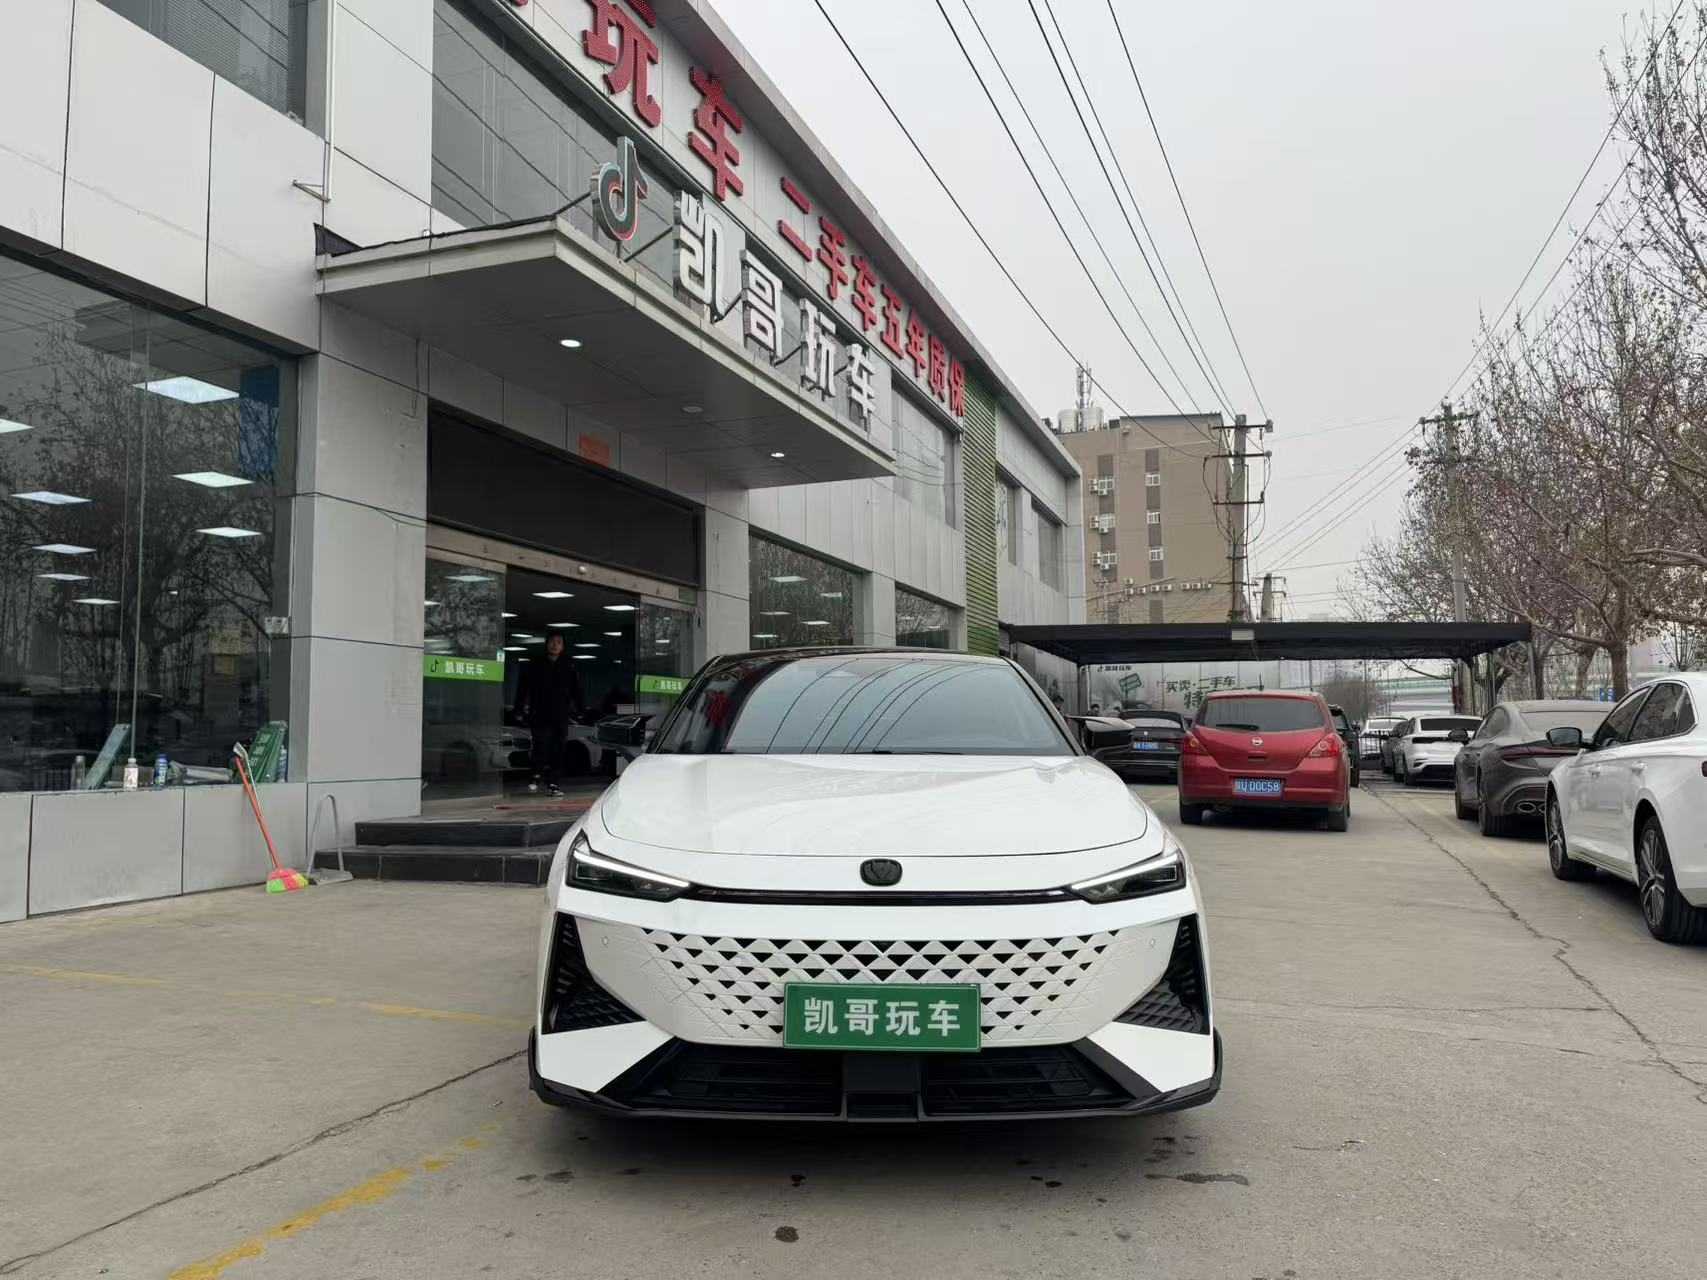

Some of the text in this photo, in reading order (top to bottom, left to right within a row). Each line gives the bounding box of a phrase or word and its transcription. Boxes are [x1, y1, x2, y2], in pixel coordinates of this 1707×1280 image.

[675, 190, 877, 427] 凯哥玩车
[777, 176, 965, 417] 二手车五年质保
[803, 997, 961, 1037] 凯哥玩车
